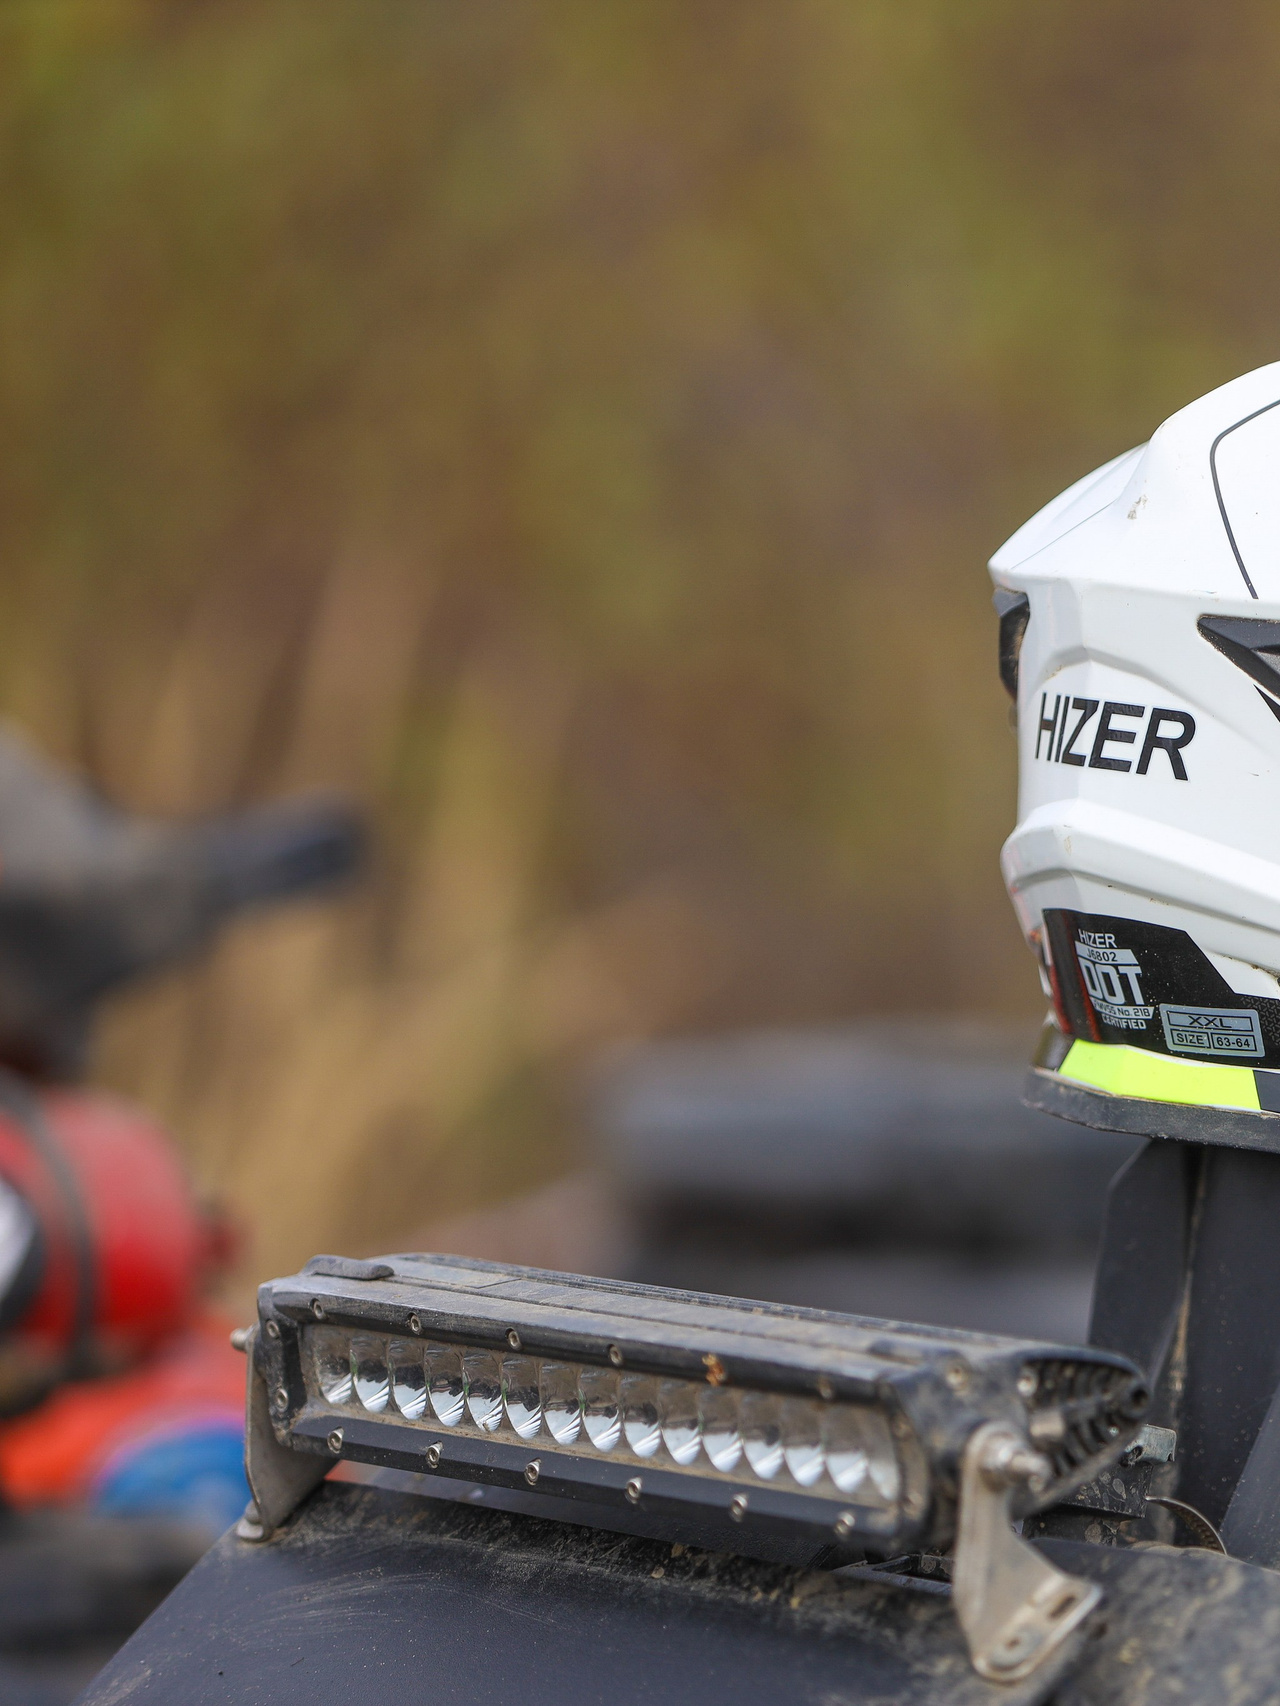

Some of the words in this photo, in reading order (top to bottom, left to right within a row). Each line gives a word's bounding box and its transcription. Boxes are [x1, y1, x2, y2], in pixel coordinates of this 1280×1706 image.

[1034, 691, 1197, 782] HIZER
[1078, 928, 1118, 949] HIZER
[1087, 947, 1118, 962] J6802
[1078, 956, 1145, 1006] DOT
[1133, 1008, 1151, 1017] 218
[1101, 1014, 1147, 1030] CERTIFIED
[1188, 1015, 1232, 1028] XXL
[1176, 1033, 1205, 1045] SIZE
[1216, 1036, 1251, 1048] 63-64
